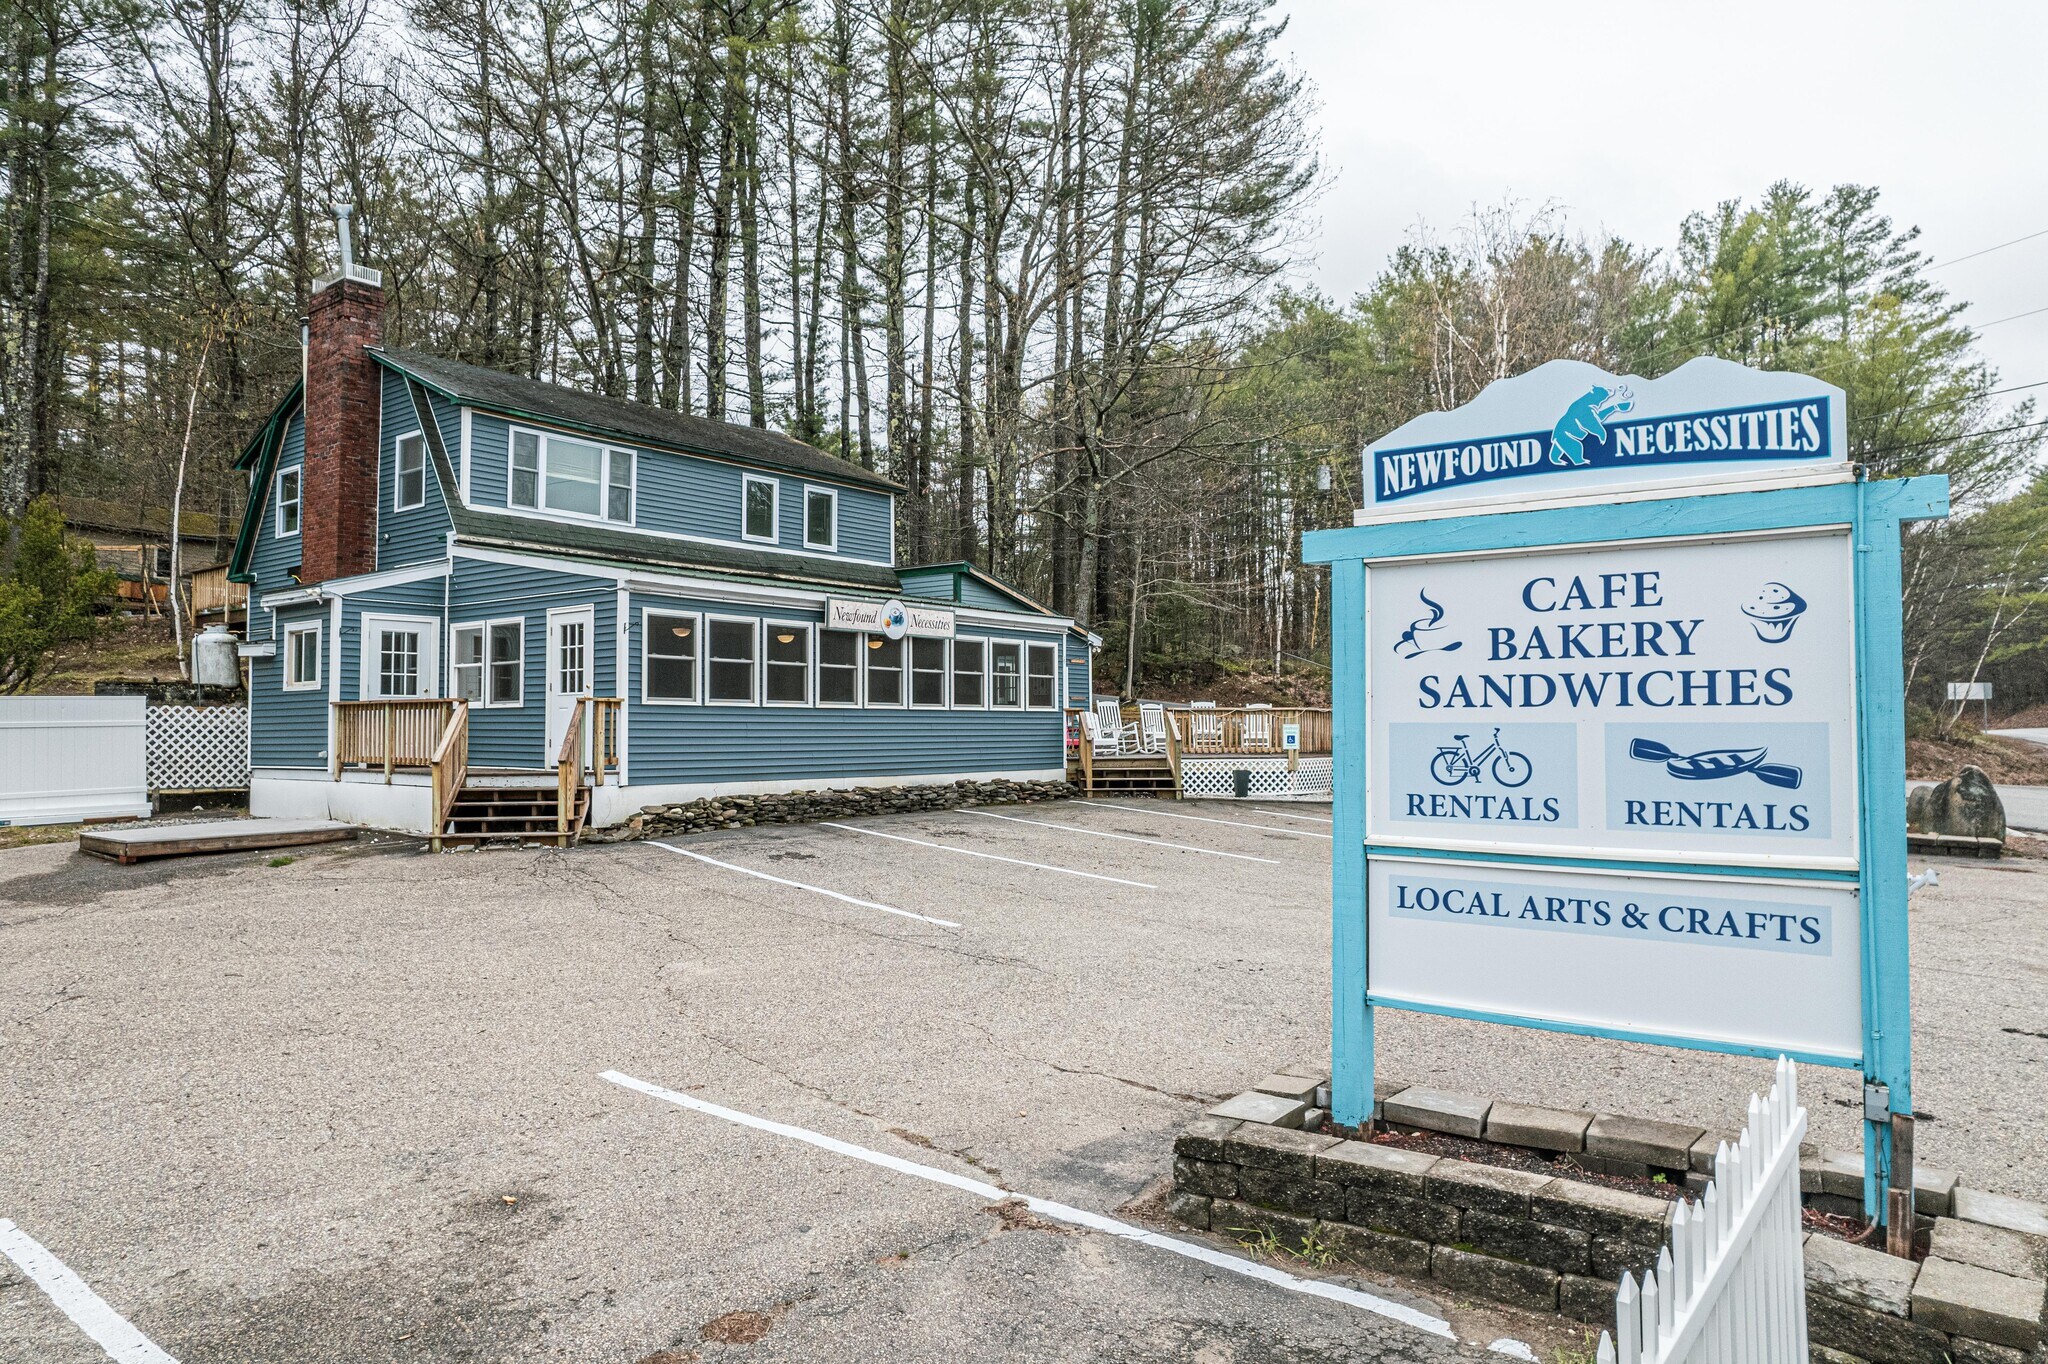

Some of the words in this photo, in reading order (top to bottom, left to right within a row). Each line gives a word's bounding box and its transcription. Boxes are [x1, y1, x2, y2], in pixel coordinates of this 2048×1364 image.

[1382, 438, 1542, 497] NEWFOUND
[1614, 403, 1822, 458] NECESSITIES
[1522, 571, 1663, 613] CAFE
[833, 606, 878, 625] Newfound
[910, 613, 951, 631] Necessities
[1487, 619, 1705, 661] BAKERY
[1418, 667, 1793, 709] SANDWICHES
[1406, 793, 1560, 822] RENTALS
[1624, 800, 1810, 832] RENTALS
[1396, 885, 1510, 918] LOCAL
[1517, 894, 1611, 927] ARTS
[1621, 902, 1650, 930] &
[1658, 905, 1822, 945] CRAFTS
